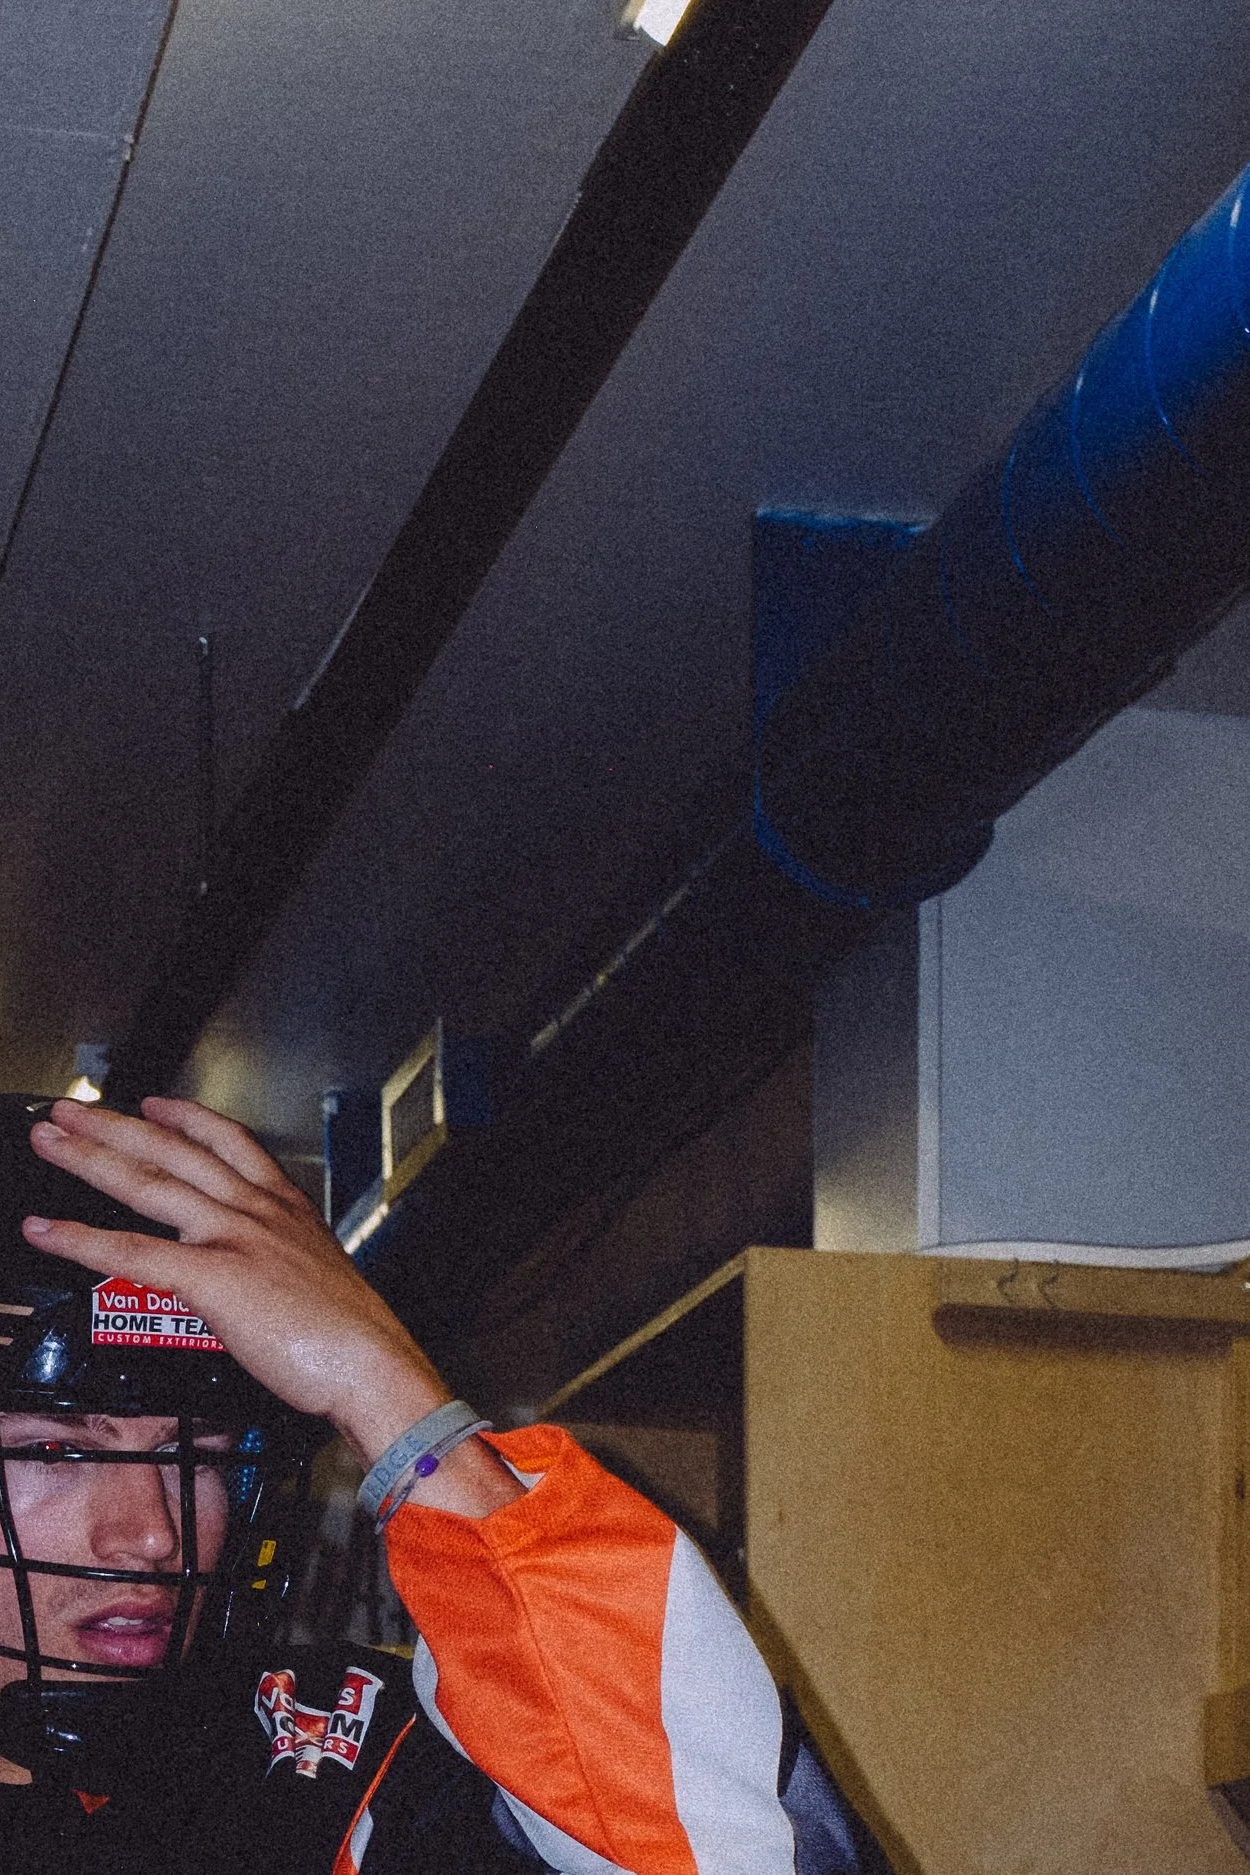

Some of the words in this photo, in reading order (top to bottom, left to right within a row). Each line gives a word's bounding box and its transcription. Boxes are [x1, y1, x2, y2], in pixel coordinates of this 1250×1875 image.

[101, 1291, 139, 1309] Van
[93, 1313, 163, 1333] HOME
[97, 1333, 152, 1344] CUSTOM
[158, 1336, 225, 1350] EXTERIORS
